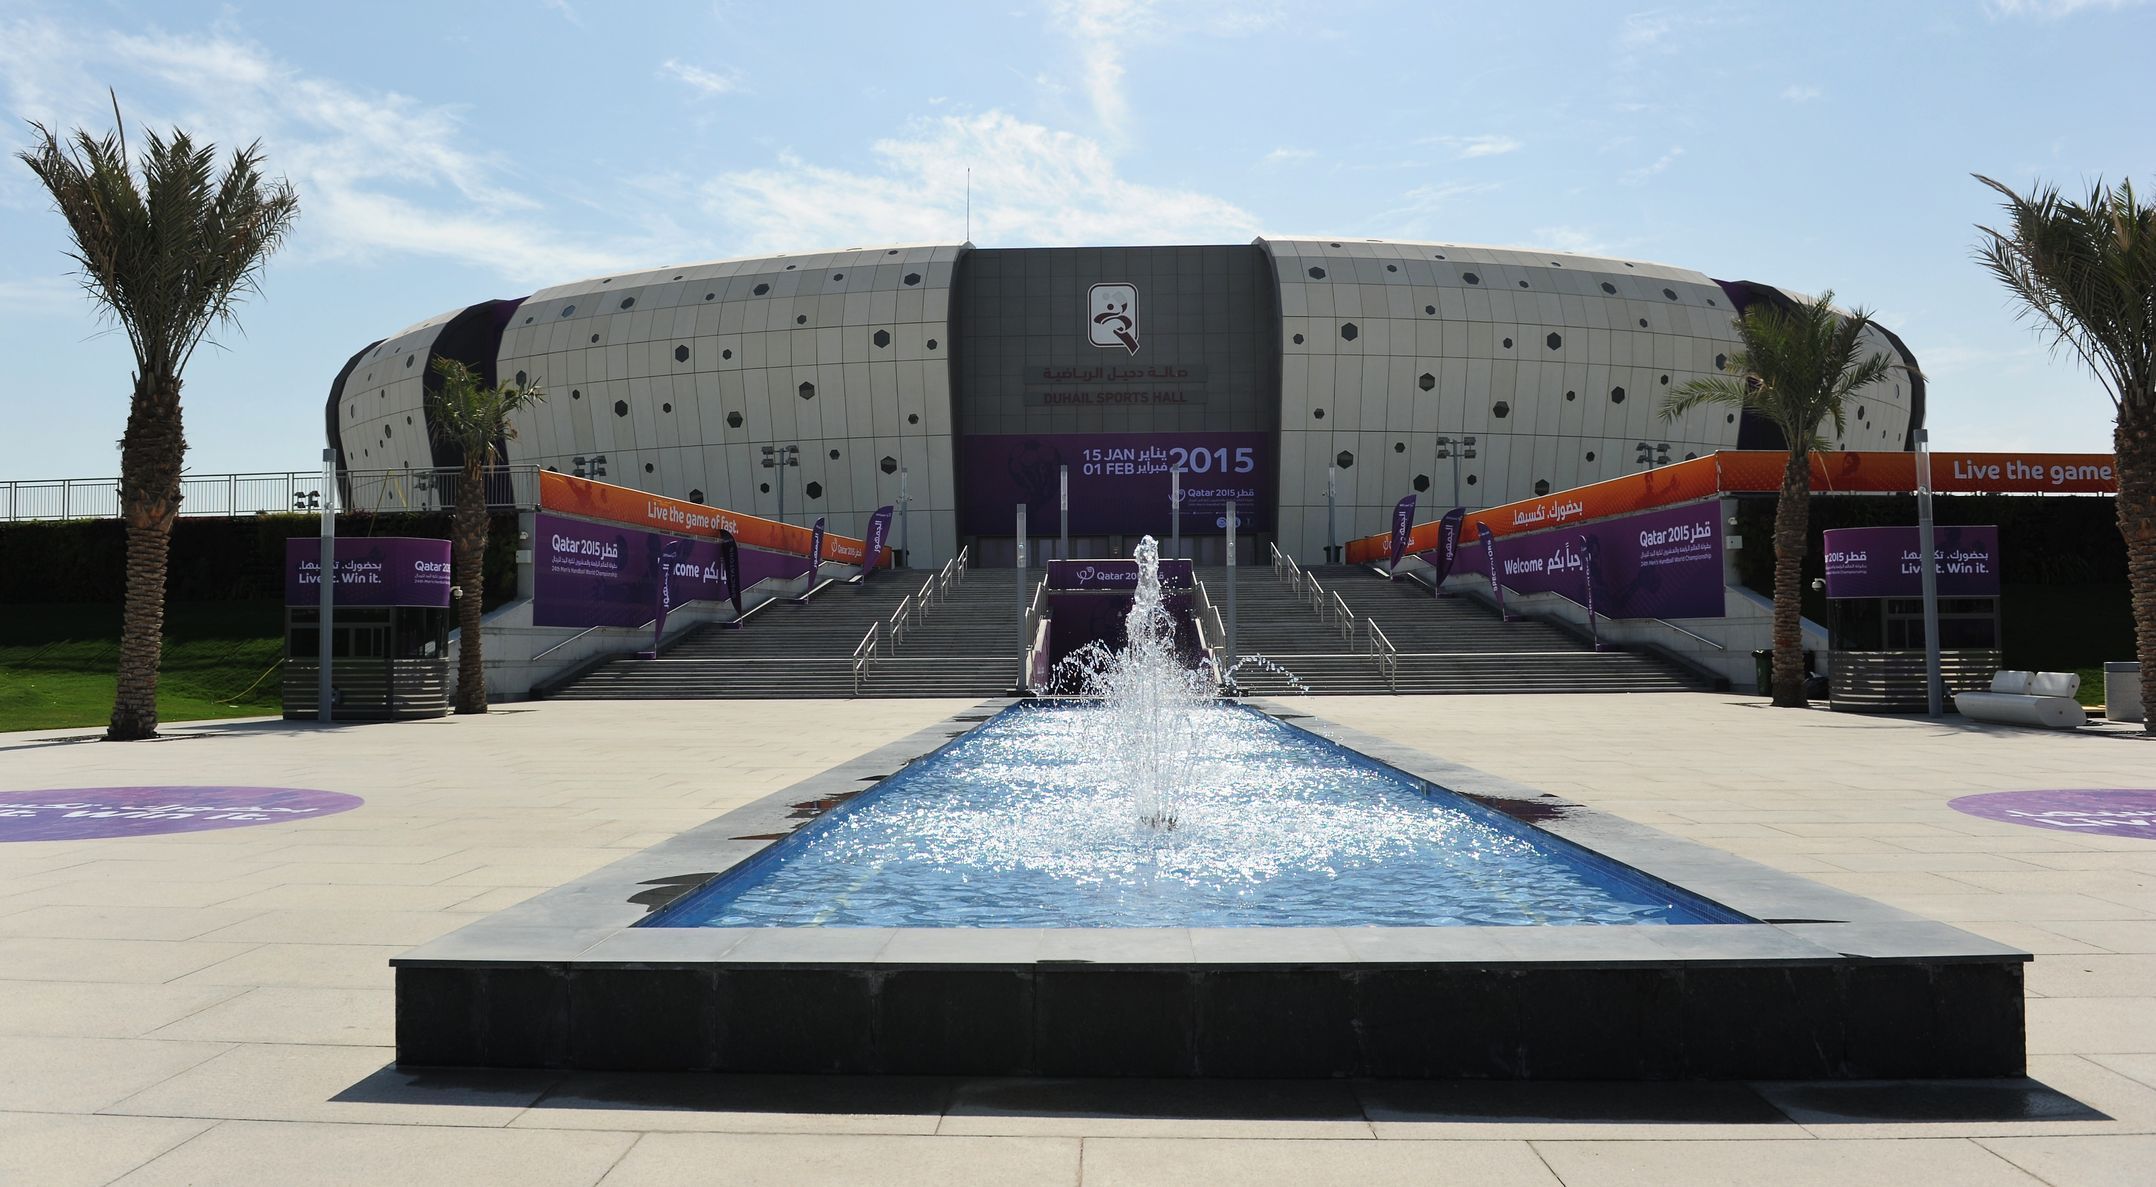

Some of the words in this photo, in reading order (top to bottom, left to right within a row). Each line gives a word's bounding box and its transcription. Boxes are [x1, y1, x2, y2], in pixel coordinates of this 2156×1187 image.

[1043, 367, 1103, 382] الرياضية
[1107, 366, 1144, 381] دحيل
[1147, 366, 1188, 378] صالة
[1043, 392, 1093, 403] DUHAIL
[1096, 392, 1149, 403] SPORTS
[1152, 391, 1187, 403] HALL
[1083, 449, 1101, 461] 15
[1104, 449, 1135, 461] JAN
[1138, 446, 1167, 461] يناير
[1169, 447, 1254, 473] 2015
[1083, 464, 1101, 475] 01
[1106, 463, 1135, 475] FEB
[1136, 462, 1168, 474] فبراير
[1953, 460, 2000, 480] Live
[2006, 460, 2044, 480] the
[2050, 465, 2112, 485] game
[1187, 489, 1215, 498] Qatar
[1215, 489, 1235, 497] 2015
[1236, 489, 1254, 498] قطر
[648, 501, 668, 520] Live
[669, 506, 685, 523] the
[686, 513, 709, 529] game
[711, 515, 720, 530] of
[720, 517, 739, 534] fast.
[1640, 529, 1667, 548] Qatar
[1668, 525, 1689, 543] 2015
[1690, 521, 1711, 543] قطر
[552, 534, 580, 552] Qatar
[581, 539, 600, 556] 2015
[600, 542, 618, 560] قطر
[1504, 557, 1543, 575] Welcome
[1547, 549, 1565, 575] بكم
[1845, 551, 1867, 563] قطر
[1947, 550, 1988, 561] بحضورك.
[342, 560, 382, 571] بحضورك.
[414, 560, 442, 572] Qatar
[703, 561, 719, 583] بكم
[1947, 563, 1973, 574] Win
[1975, 563, 1989, 574] it.
[341, 573, 366, 584] Win
[368, 573, 382, 584] it.
[1097, 571, 1124, 581] Qatar
